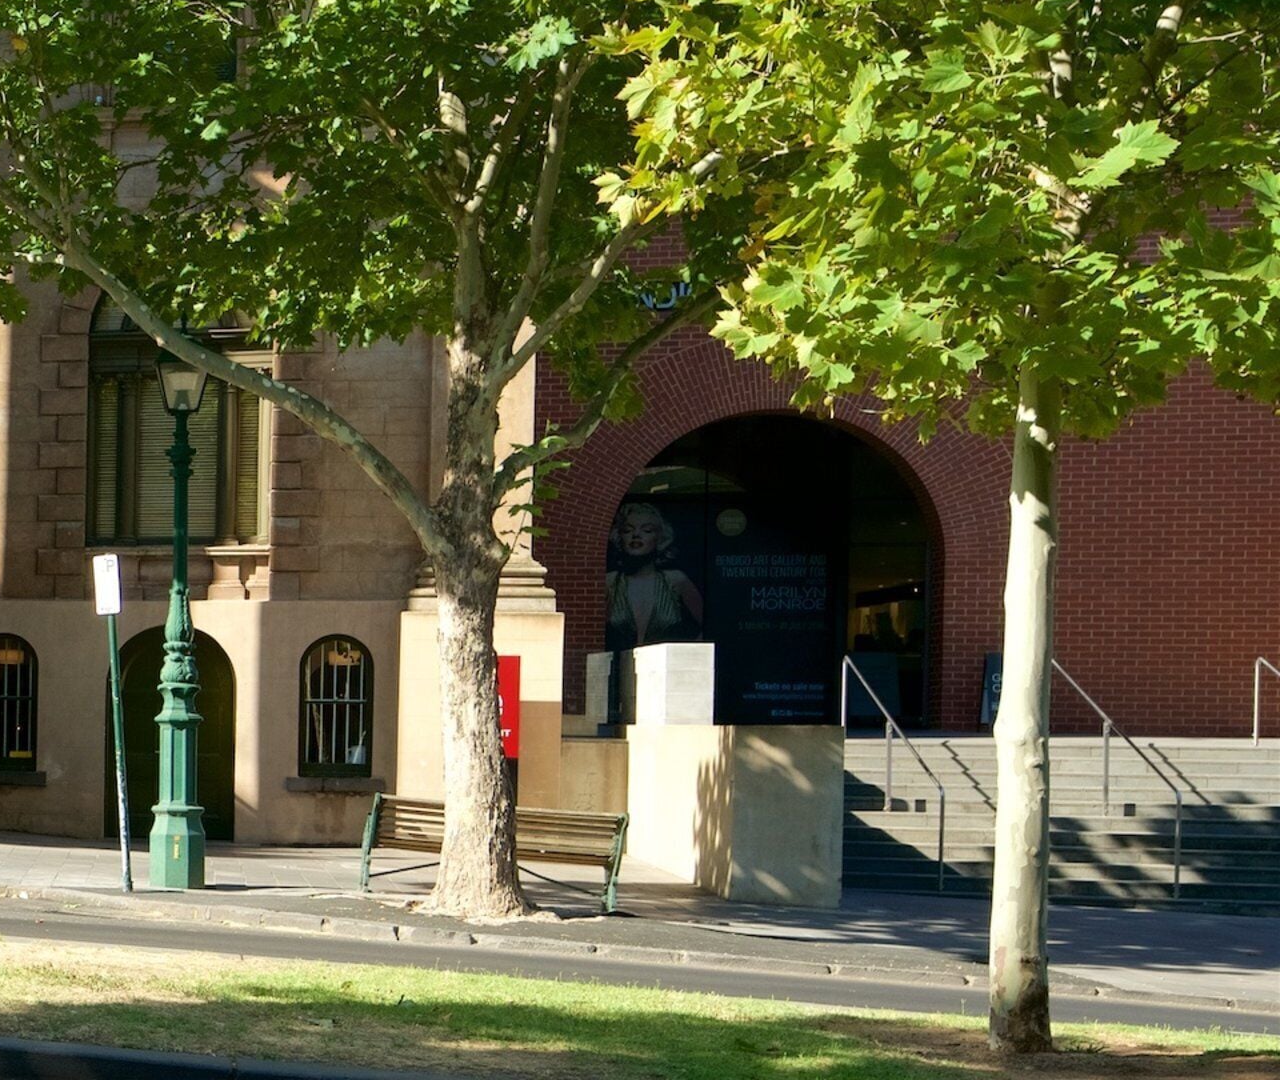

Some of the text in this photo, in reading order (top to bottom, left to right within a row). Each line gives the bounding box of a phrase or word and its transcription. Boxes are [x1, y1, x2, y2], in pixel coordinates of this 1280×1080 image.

[752, 555, 769, 566] ART
[771, 555, 806, 566] GALLERY
[721, 566, 768, 578] TWENTIETH
[770, 566, 806, 577] CENTURY
[751, 586, 827, 598] MARILYN
[751, 598, 826, 610] MONROE
[754, 681, 780, 690] Tickets
